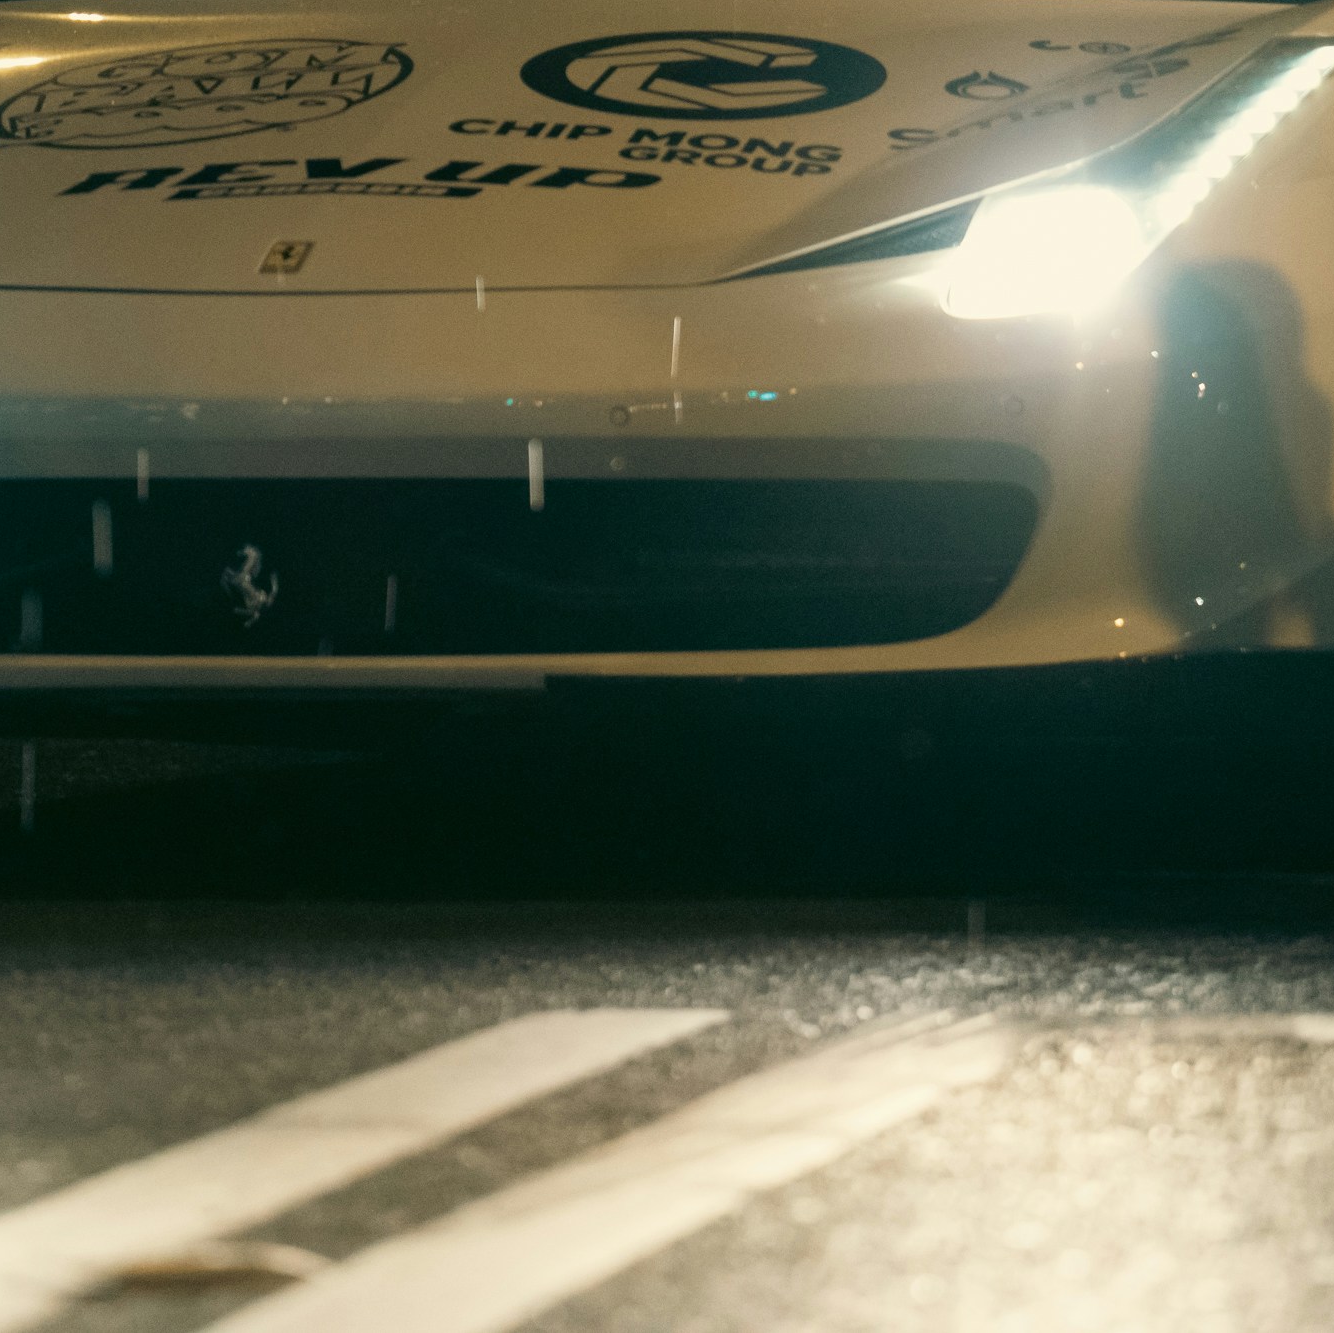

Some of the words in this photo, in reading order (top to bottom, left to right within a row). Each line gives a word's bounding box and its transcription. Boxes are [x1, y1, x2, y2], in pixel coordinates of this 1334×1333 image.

[447, 117, 612, 144] CHIP
[627, 127, 844, 164] MONG
[618, 146, 834, 178] GROUP
